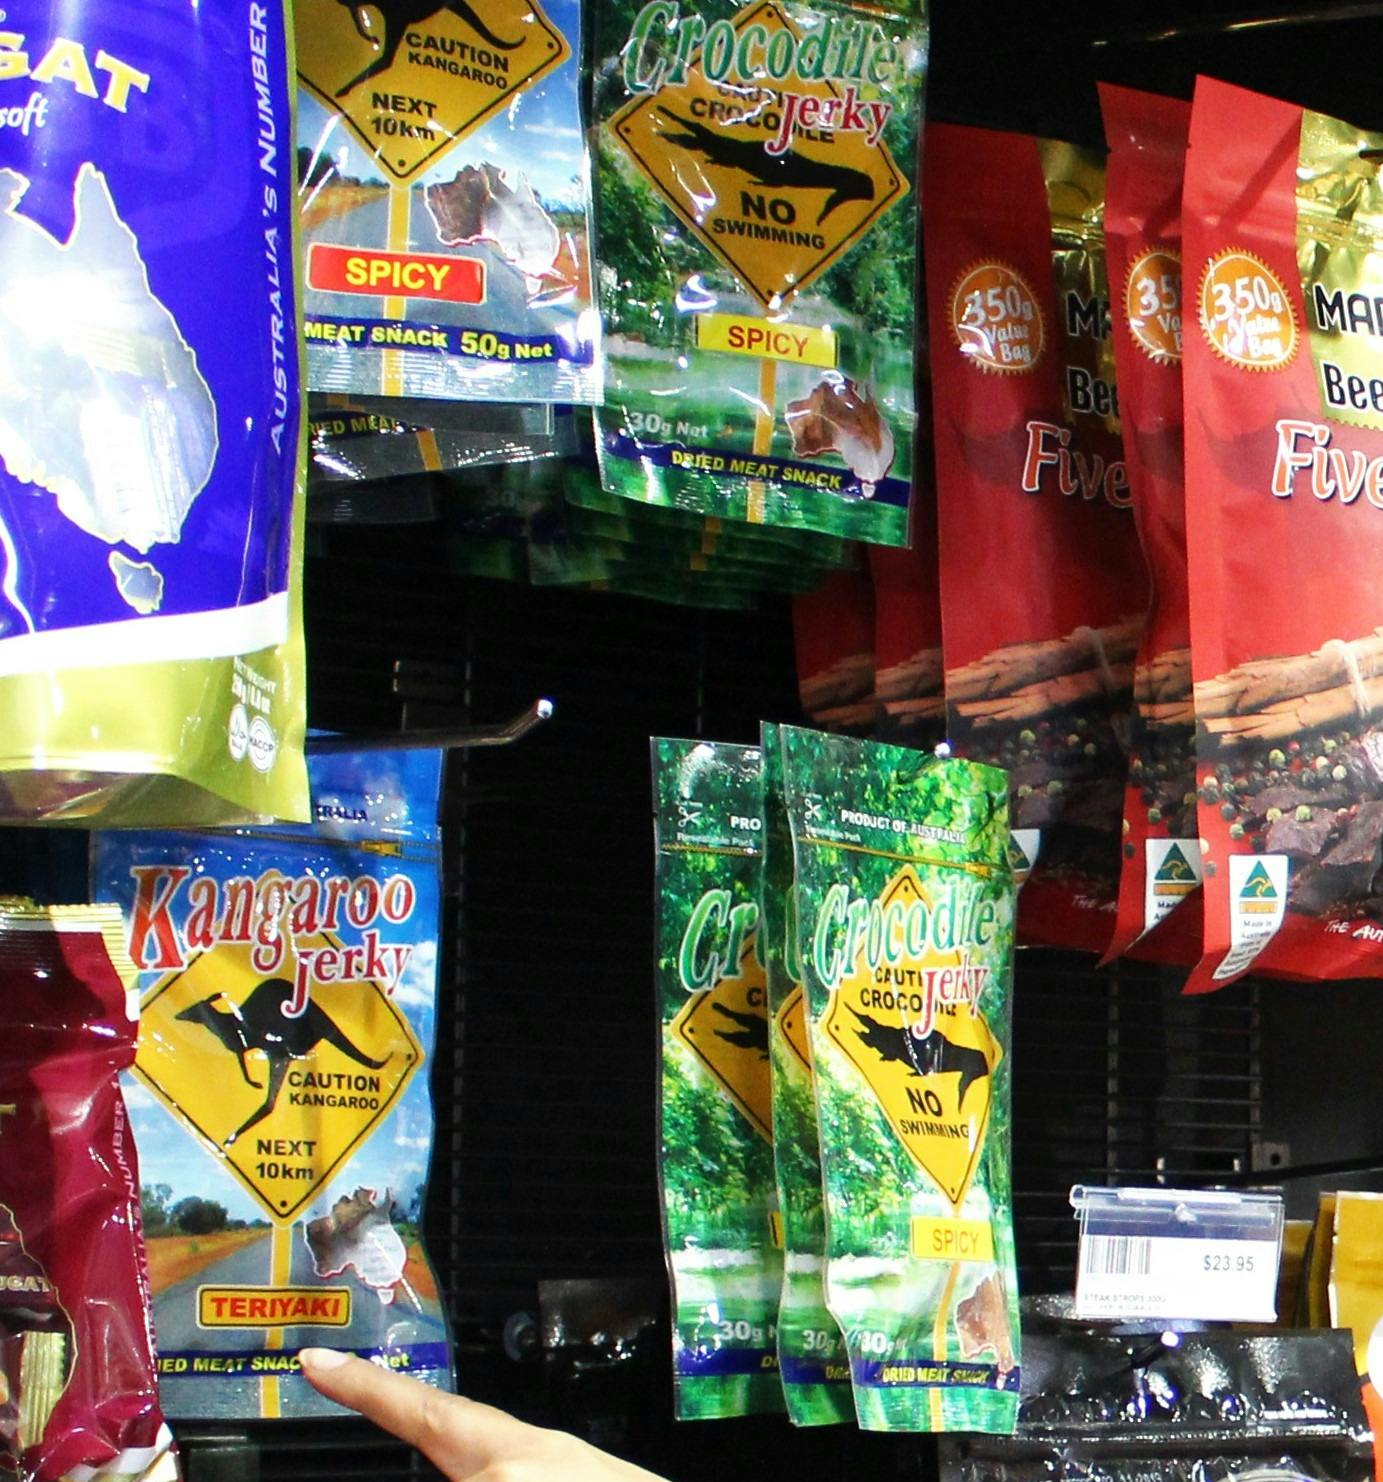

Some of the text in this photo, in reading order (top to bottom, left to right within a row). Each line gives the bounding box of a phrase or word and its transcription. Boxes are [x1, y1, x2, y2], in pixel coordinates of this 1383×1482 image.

[404, 31, 510, 73] CAUTION
[624, 1, 898, 94] Crocodile
[408, 52, 508, 91] KANGAROO
[371, 92, 438, 118] NEXT
[372, 118, 436, 142] 10km
[765, 87, 892, 156] Jerky
[741, 192, 796, 226] NO
[247, 2, 286, 454] AUSTRALIA'S NUMBER
[712, 217, 826, 250] SWIMMING
[345, 256, 451, 291] SPICY
[963, 288, 1034, 329] 350g
[1210, 277, 1284, 321] 350g
[304, 323, 553, 359] MEAT SNACK 50g Net
[728, 325, 809, 358] SPICY
[985, 324, 1029, 343] Value
[1000, 343, 1032, 363] Bag
[309, 417, 346, 438] RIED
[631, 411, 708, 438] 30g Net
[671, 450, 843, 490] DRIED MEAT SNACK
[1022, 421, 1133, 508] Five
[841, 808, 889, 832] PRODUCT
[128, 865, 416, 975] Kangaroo
[811, 877, 996, 991] Crocodile
[1323, 918, 1349, 935] THE
[281, 930, 413, 1018] Jerky
[859, 987, 957, 1017] CROCOILE
[916, 953, 990, 1041] Jerky
[288, 1072, 381, 1093] CAUTION
[289, 1092, 380, 1111] KANGAROO
[906, 1087, 943, 1118] NO
[899, 1118, 970, 1140] SWIMMING
[113, 1100, 138, 1199] NUMBER
[256, 1139, 318, 1157] NEXT
[256, 1162, 315, 1181] 10km
[932, 1229, 980, 1254] SPICY
[211, 1295, 341, 1319] TERIYAKI
[720, 1320, 763, 1342] 30g
[157, 1354, 302, 1375] IED MEAT SNAC
[917, 1366, 949, 1383] MEAT
